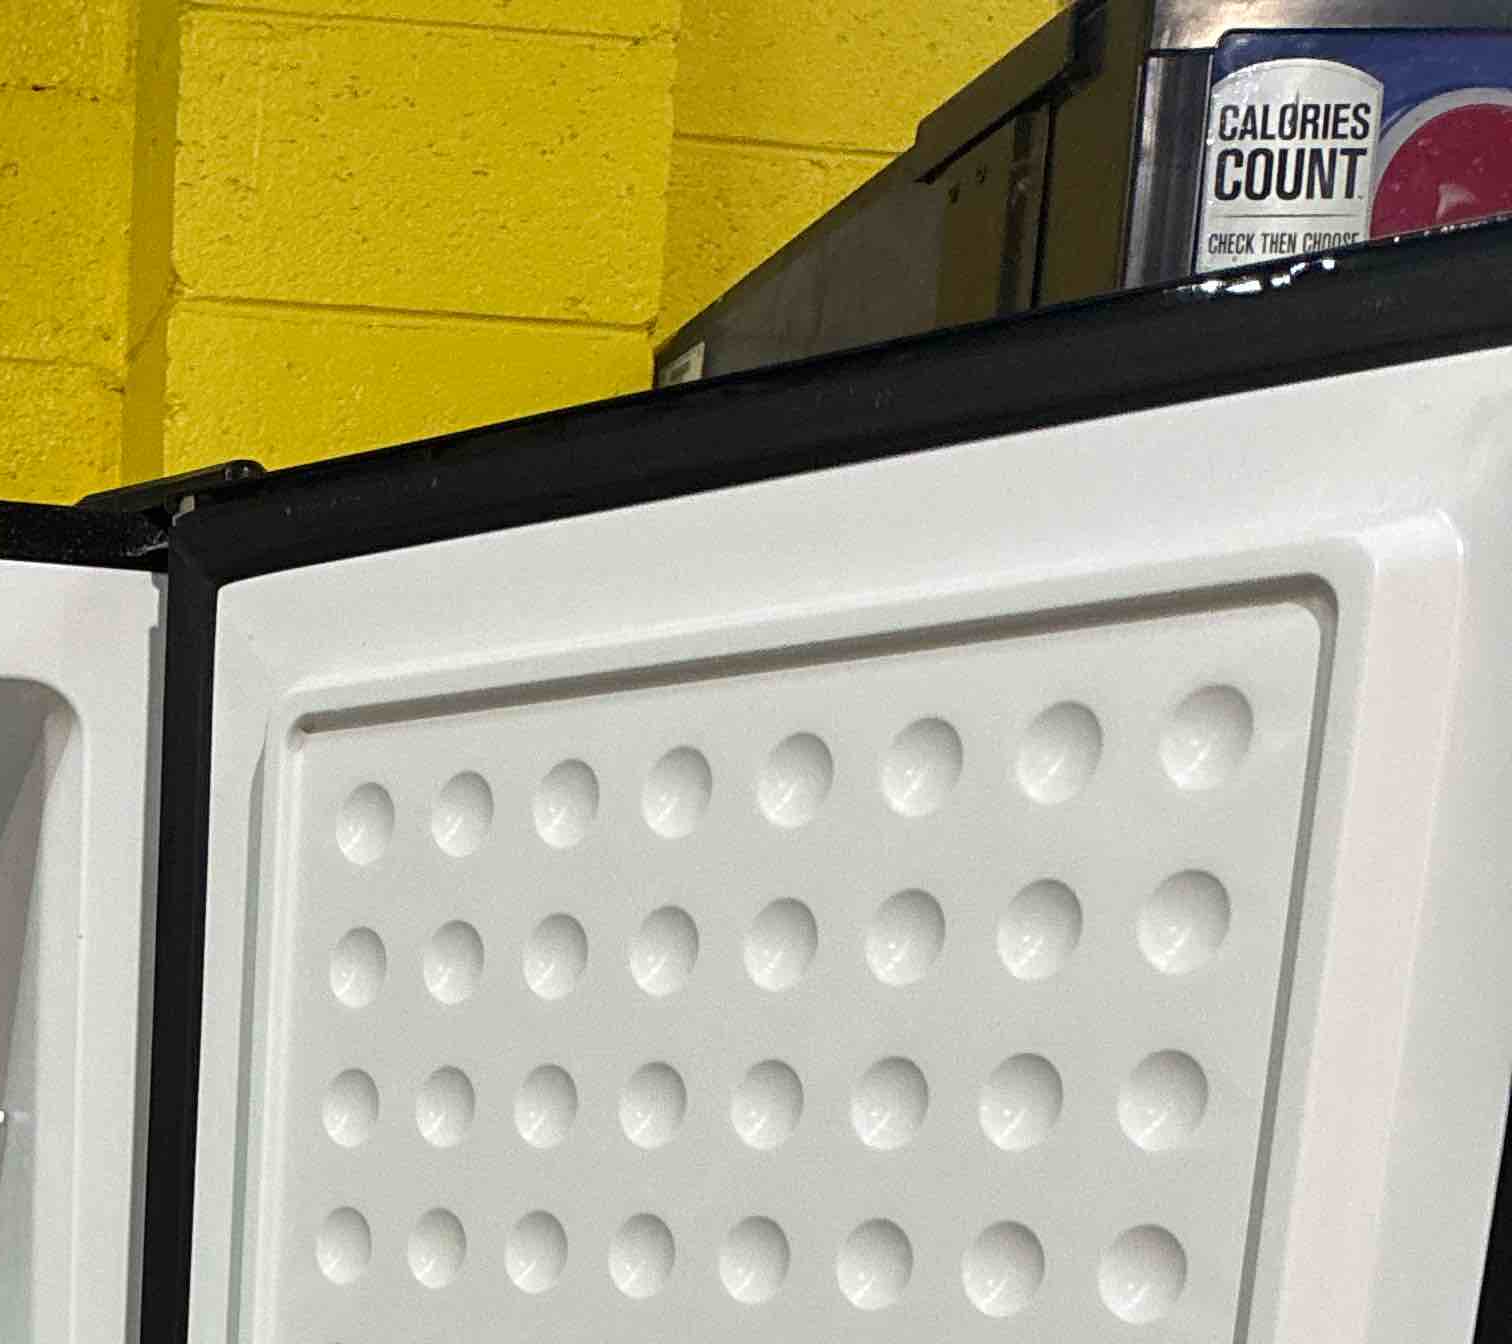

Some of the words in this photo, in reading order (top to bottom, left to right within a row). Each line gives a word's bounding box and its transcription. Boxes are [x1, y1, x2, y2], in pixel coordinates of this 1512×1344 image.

[1220, 104, 1370, 140] CALORIES
[1215, 148, 1367, 201] COUNT
[1208, 233, 1255, 254] CHECK
[1262, 233, 1297, 254] THEN
